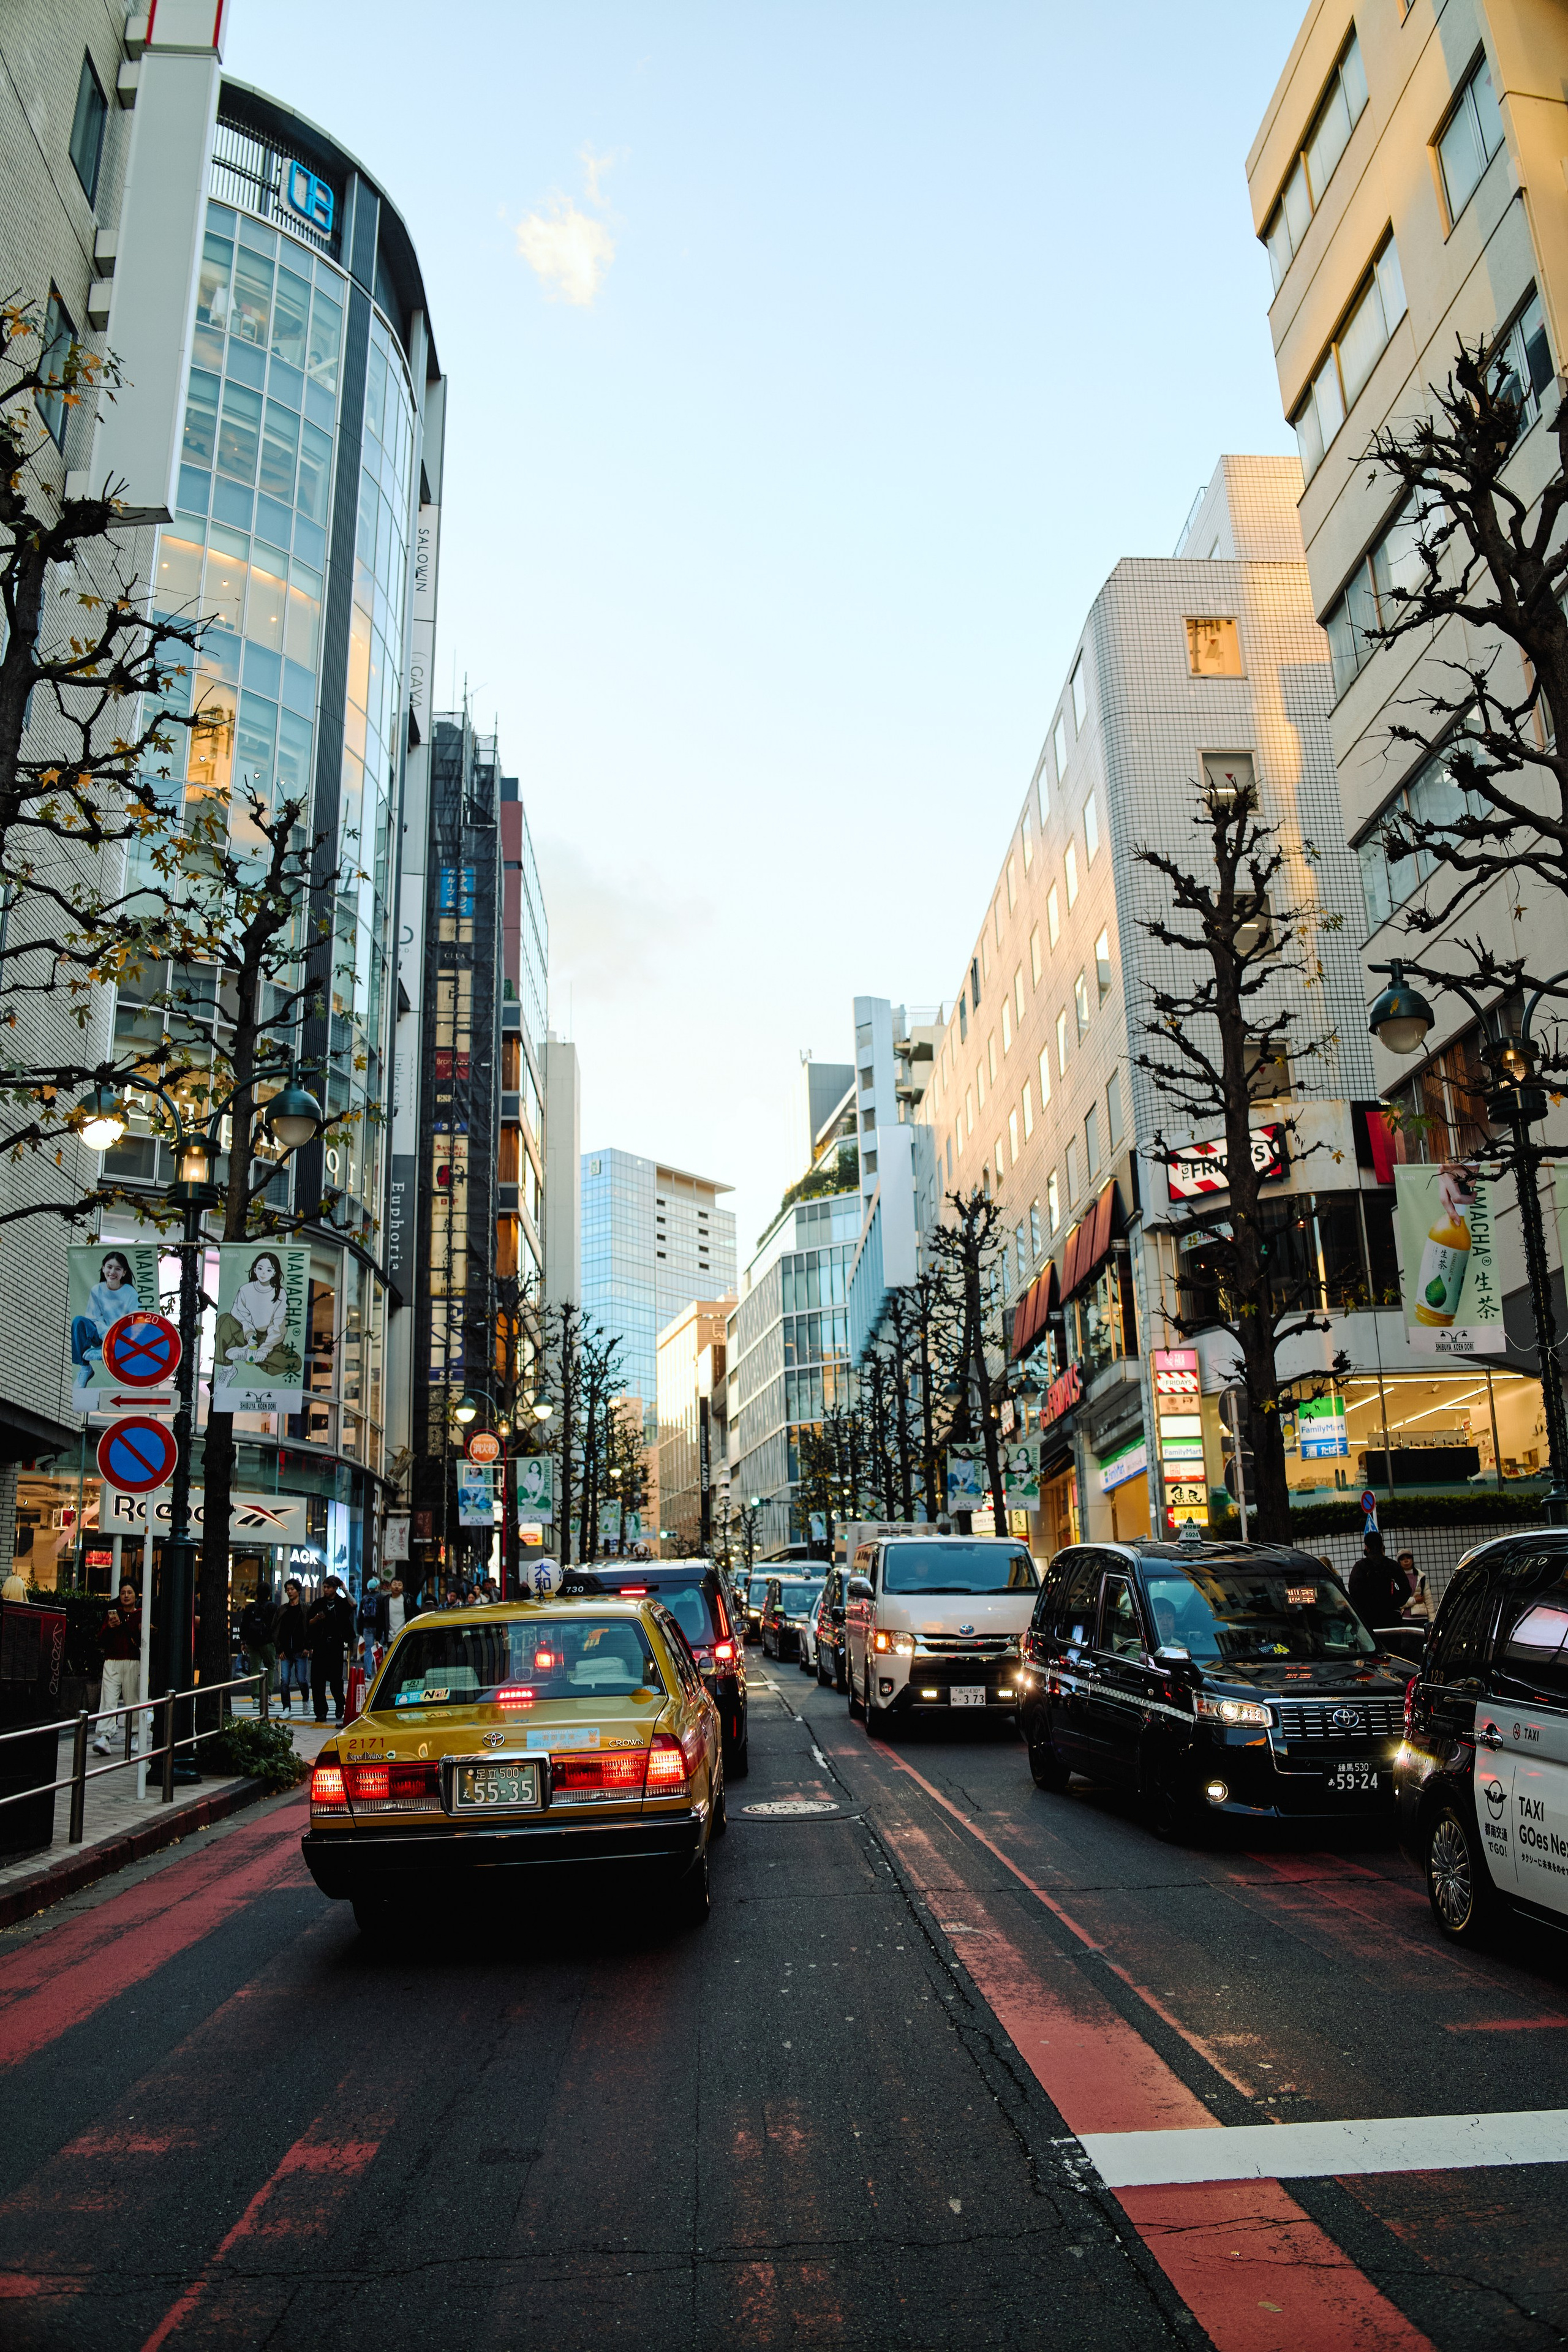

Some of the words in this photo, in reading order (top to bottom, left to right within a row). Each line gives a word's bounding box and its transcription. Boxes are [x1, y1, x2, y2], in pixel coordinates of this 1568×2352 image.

[416, 528, 429, 592] SALOWIN
[1191, 1145, 1265, 1178] FRIDS
[390, 1182, 405, 1270] Euphoria
[1198, 1226, 1221, 1238] YERS
[1438, 1250, 1447, 1270] 生茶
[1474, 1272, 1500, 1319] 生茶
[128, 1314, 159, 1324] 7-20
[282, 1341, 302, 1384] 生茶
[1301, 1423, 1344, 1434] FamilyMart
[473, 1442, 497, 1454] 消火栓
[1306, 1446, 1317, 1457] 酒
[1321, 1446, 1344, 1456] たばこ
[1170, 1485, 1202, 1504] 魚民
[277, 1547, 318, 1565] BACK
[534, 1563, 551, 1590] 大和
[1431, 1669, 1444, 1684] 129
[349, 1738, 385, 1749] 2171
[608, 1738, 644, 1747] CROWN
[1525, 1728, 1540, 1742] TAXI
[345, 1752, 363, 1762] Super
[363, 1752, 384, 1760] Deluxe
[1328, 1778, 1335, 1787] あ
[1336, 1773, 1378, 1790] 59-24
[462, 1789, 470, 1799] え
[474, 1779, 532, 1803] 55-35
[1519, 1796, 1544, 1822] TAXI
[1485, 1822, 1508, 1842] 都南交通
[1488, 1841, 1507, 1857] でGO!
[1519, 1824, 1548, 1852] GOes
[1551, 1833, 1568, 1860] Ne
